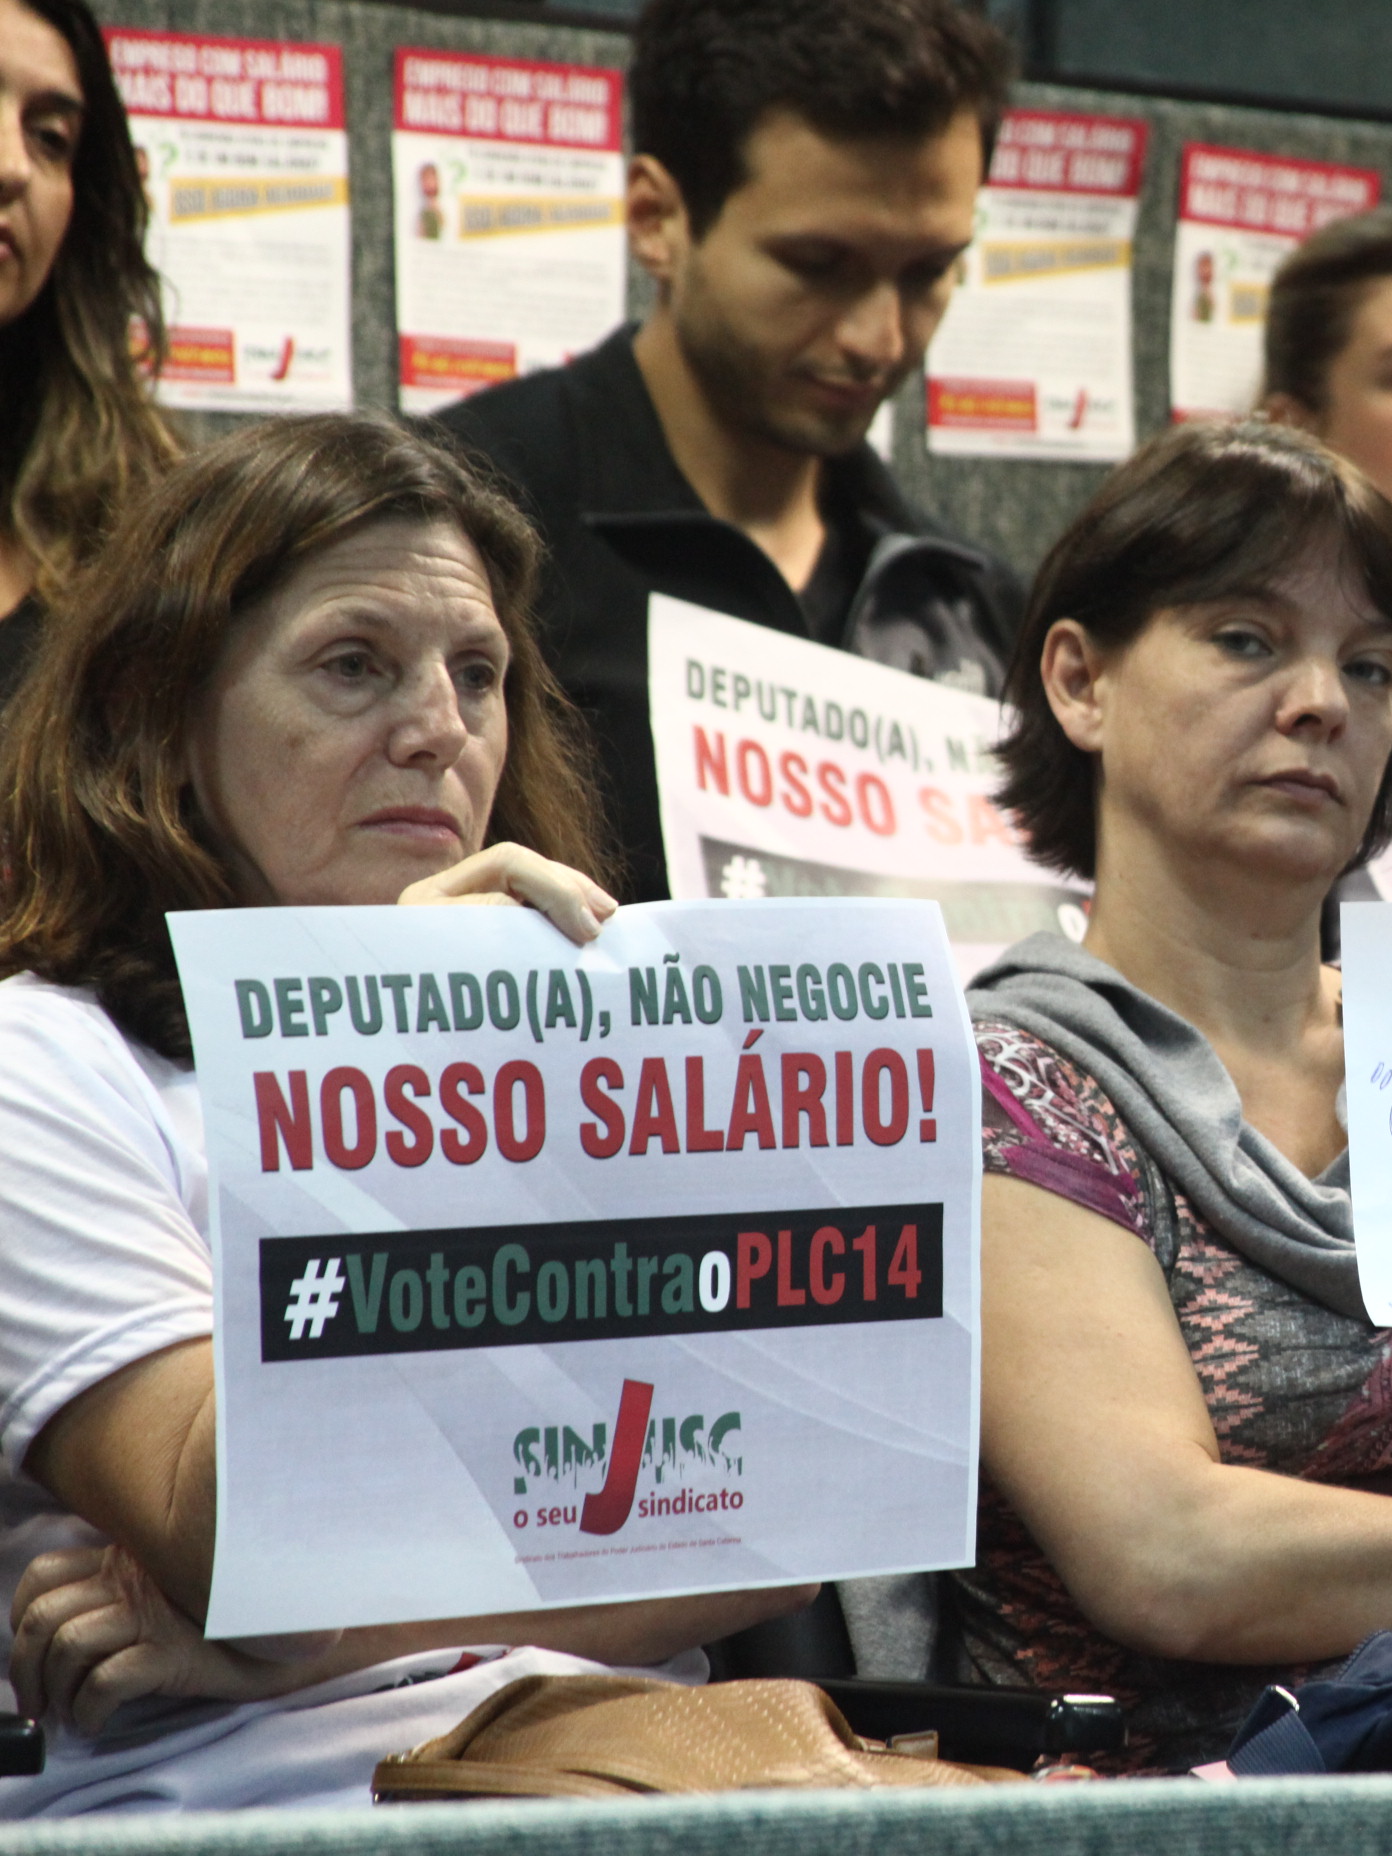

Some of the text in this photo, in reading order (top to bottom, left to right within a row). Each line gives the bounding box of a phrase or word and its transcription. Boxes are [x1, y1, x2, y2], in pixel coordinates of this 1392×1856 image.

[685, 657, 935, 774] DEPUTADO(A),
[692, 722, 898, 838] NOSSO
[235, 953, 933, 1042] DEPUTADO(A), NÃO NEGOCIE
[254, 1029, 937, 1173] NOSSO SALÁRIO!
[283, 1224, 922, 1341] #VoteContraoPLC14
[513, 1488, 744, 1529] o seu sindicato
